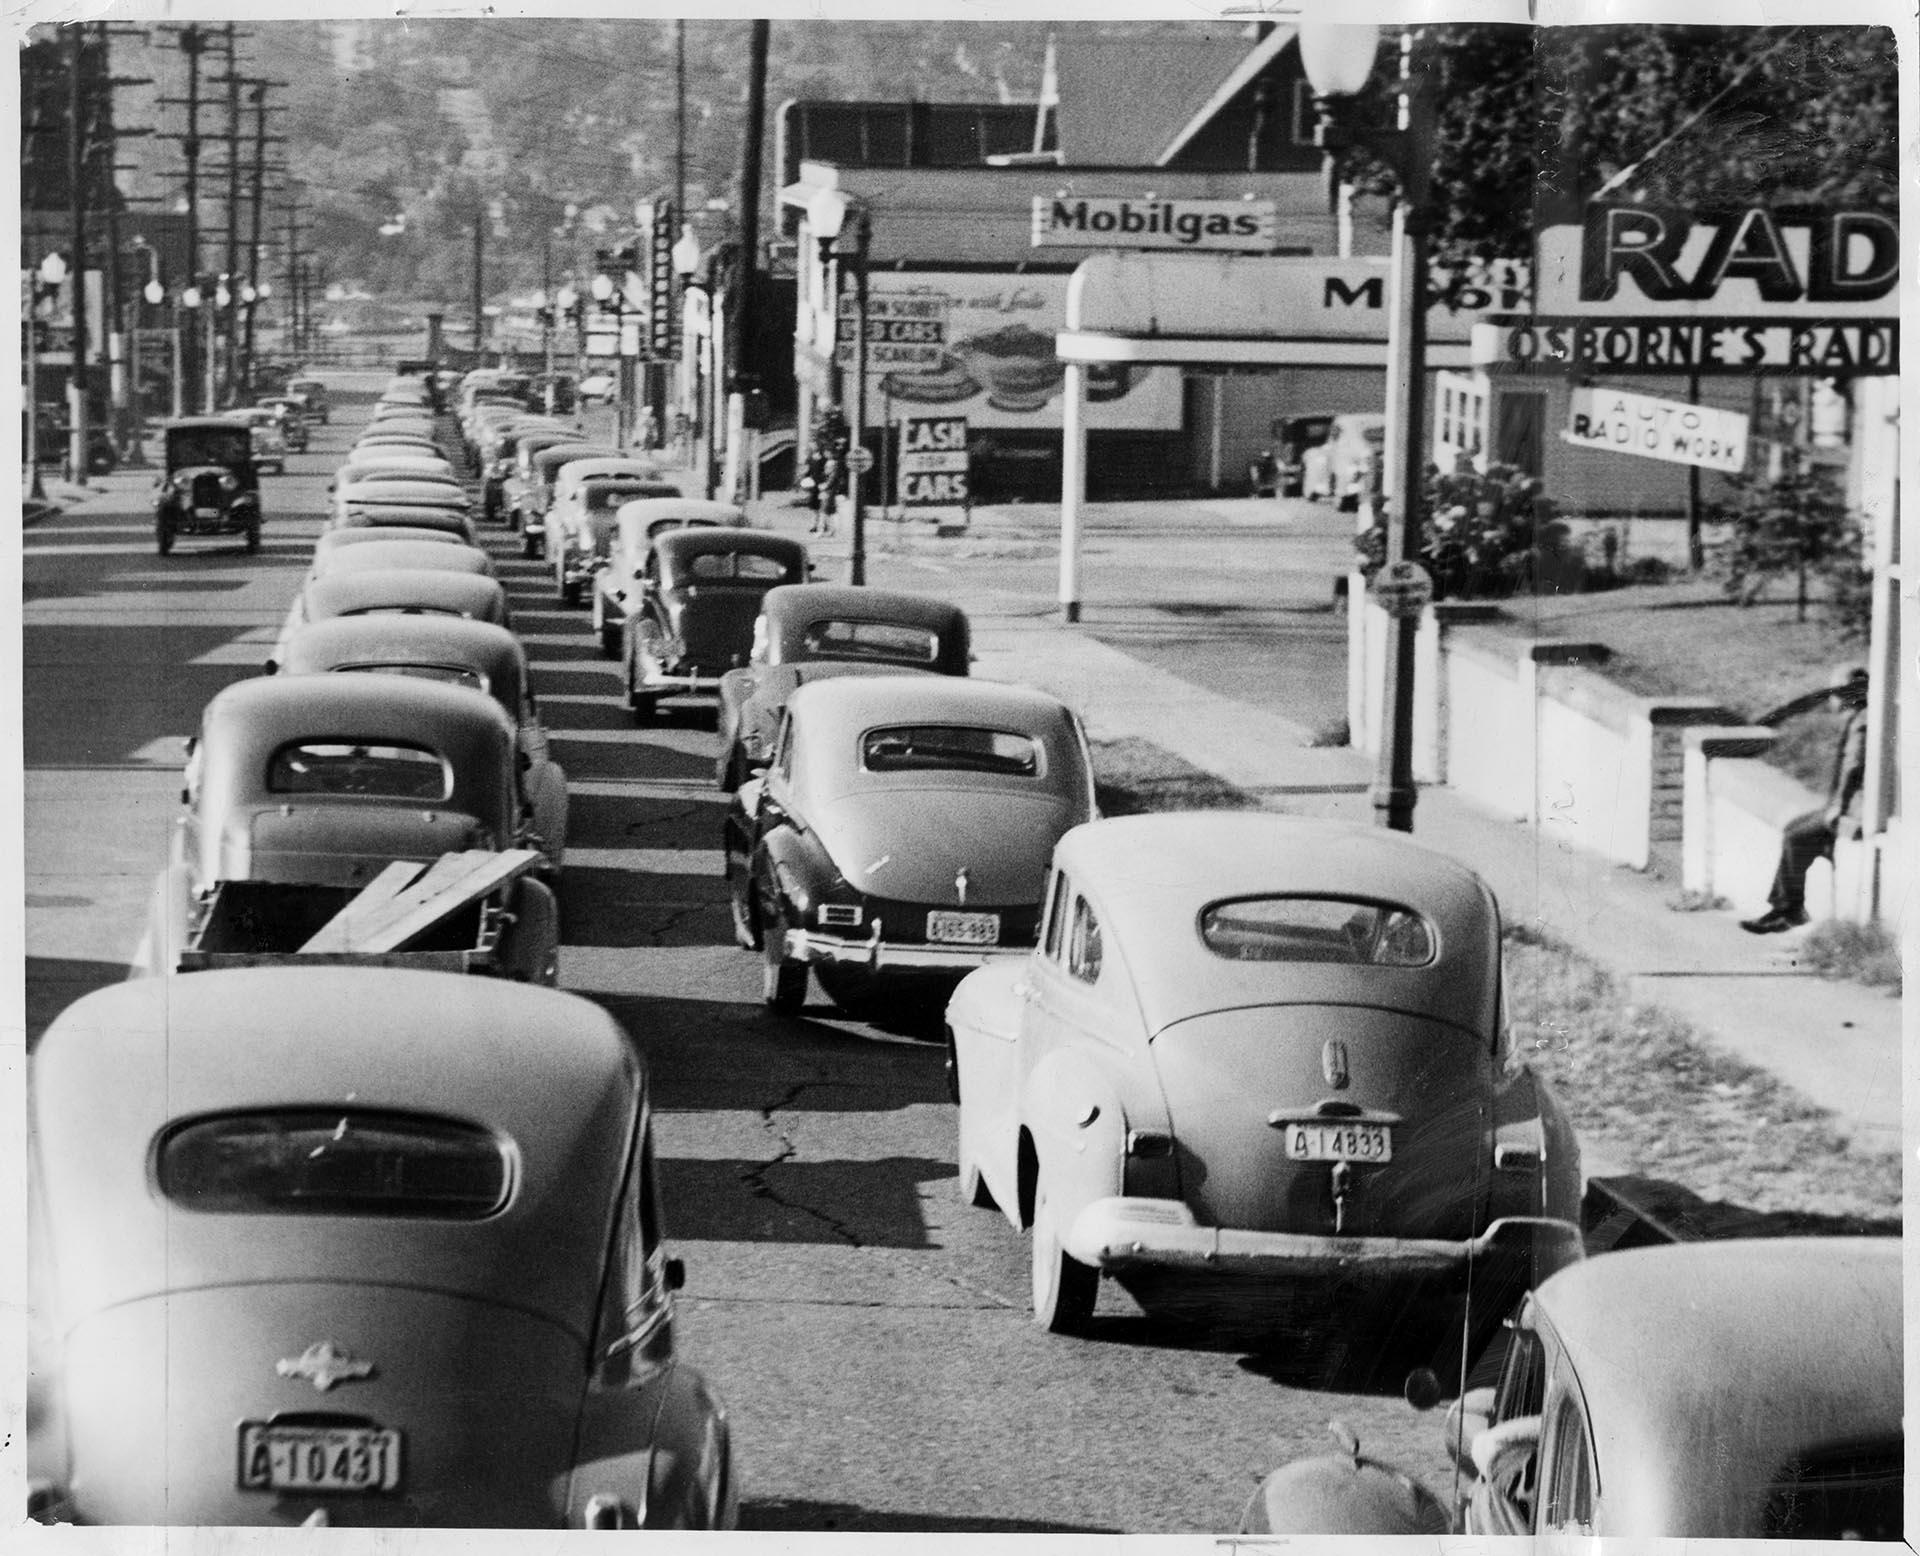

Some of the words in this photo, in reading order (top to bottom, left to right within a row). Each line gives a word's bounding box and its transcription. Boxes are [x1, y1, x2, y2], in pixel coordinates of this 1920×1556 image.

[1052, 201, 1259, 243] Mobilgas
[1579, 206, 1899, 302] RAD
[1612, 400, 1700, 430] AUTO
[902, 421, 967, 449] CASH
[900, 474, 968, 501] CARS
